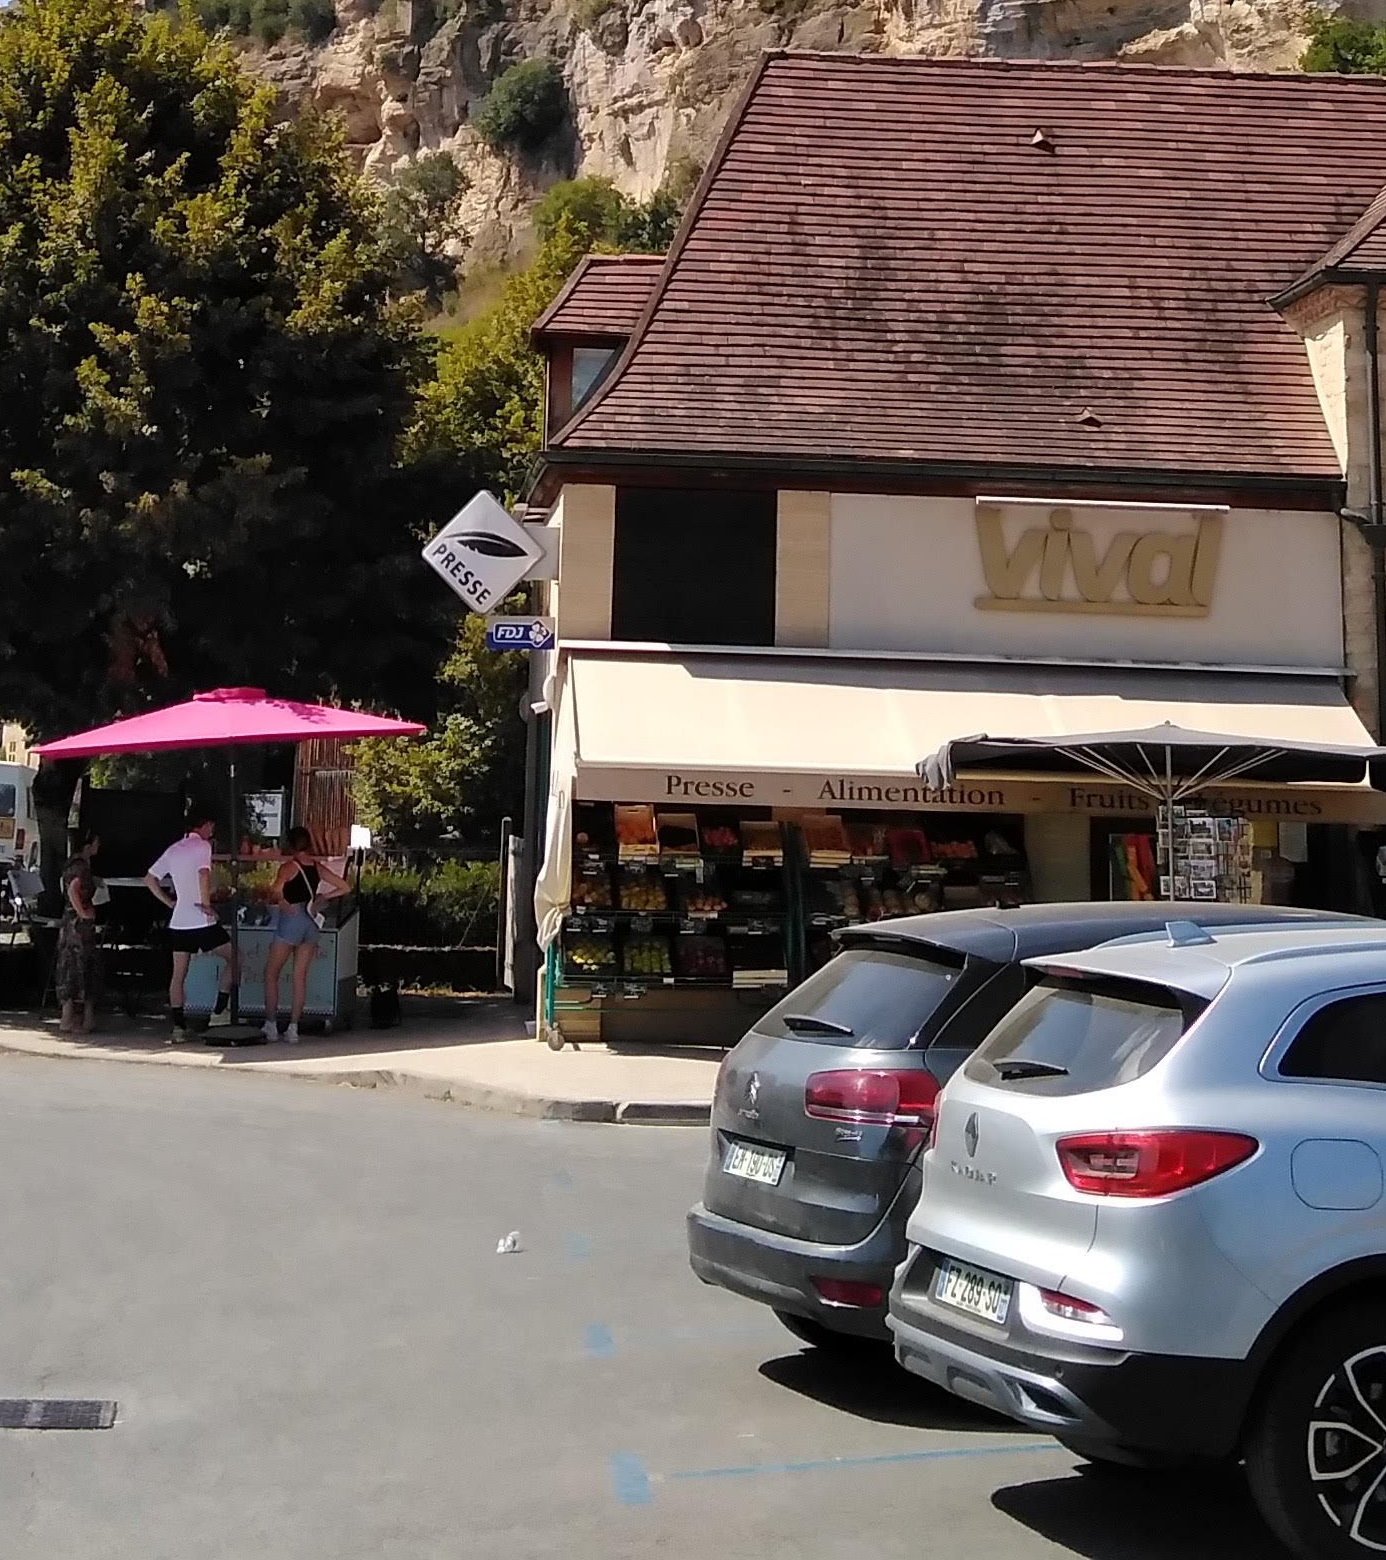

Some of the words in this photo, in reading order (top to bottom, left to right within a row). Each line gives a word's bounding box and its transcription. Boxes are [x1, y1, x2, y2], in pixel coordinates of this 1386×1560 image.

[432, 543, 492, 605] PRESSE
[497, 626, 525, 639] FDJ
[665, 775, 755, 798] Presse
[817, 778, 1005, 805] Alimentation
[1069, 788, 1150, 811] Fruits
